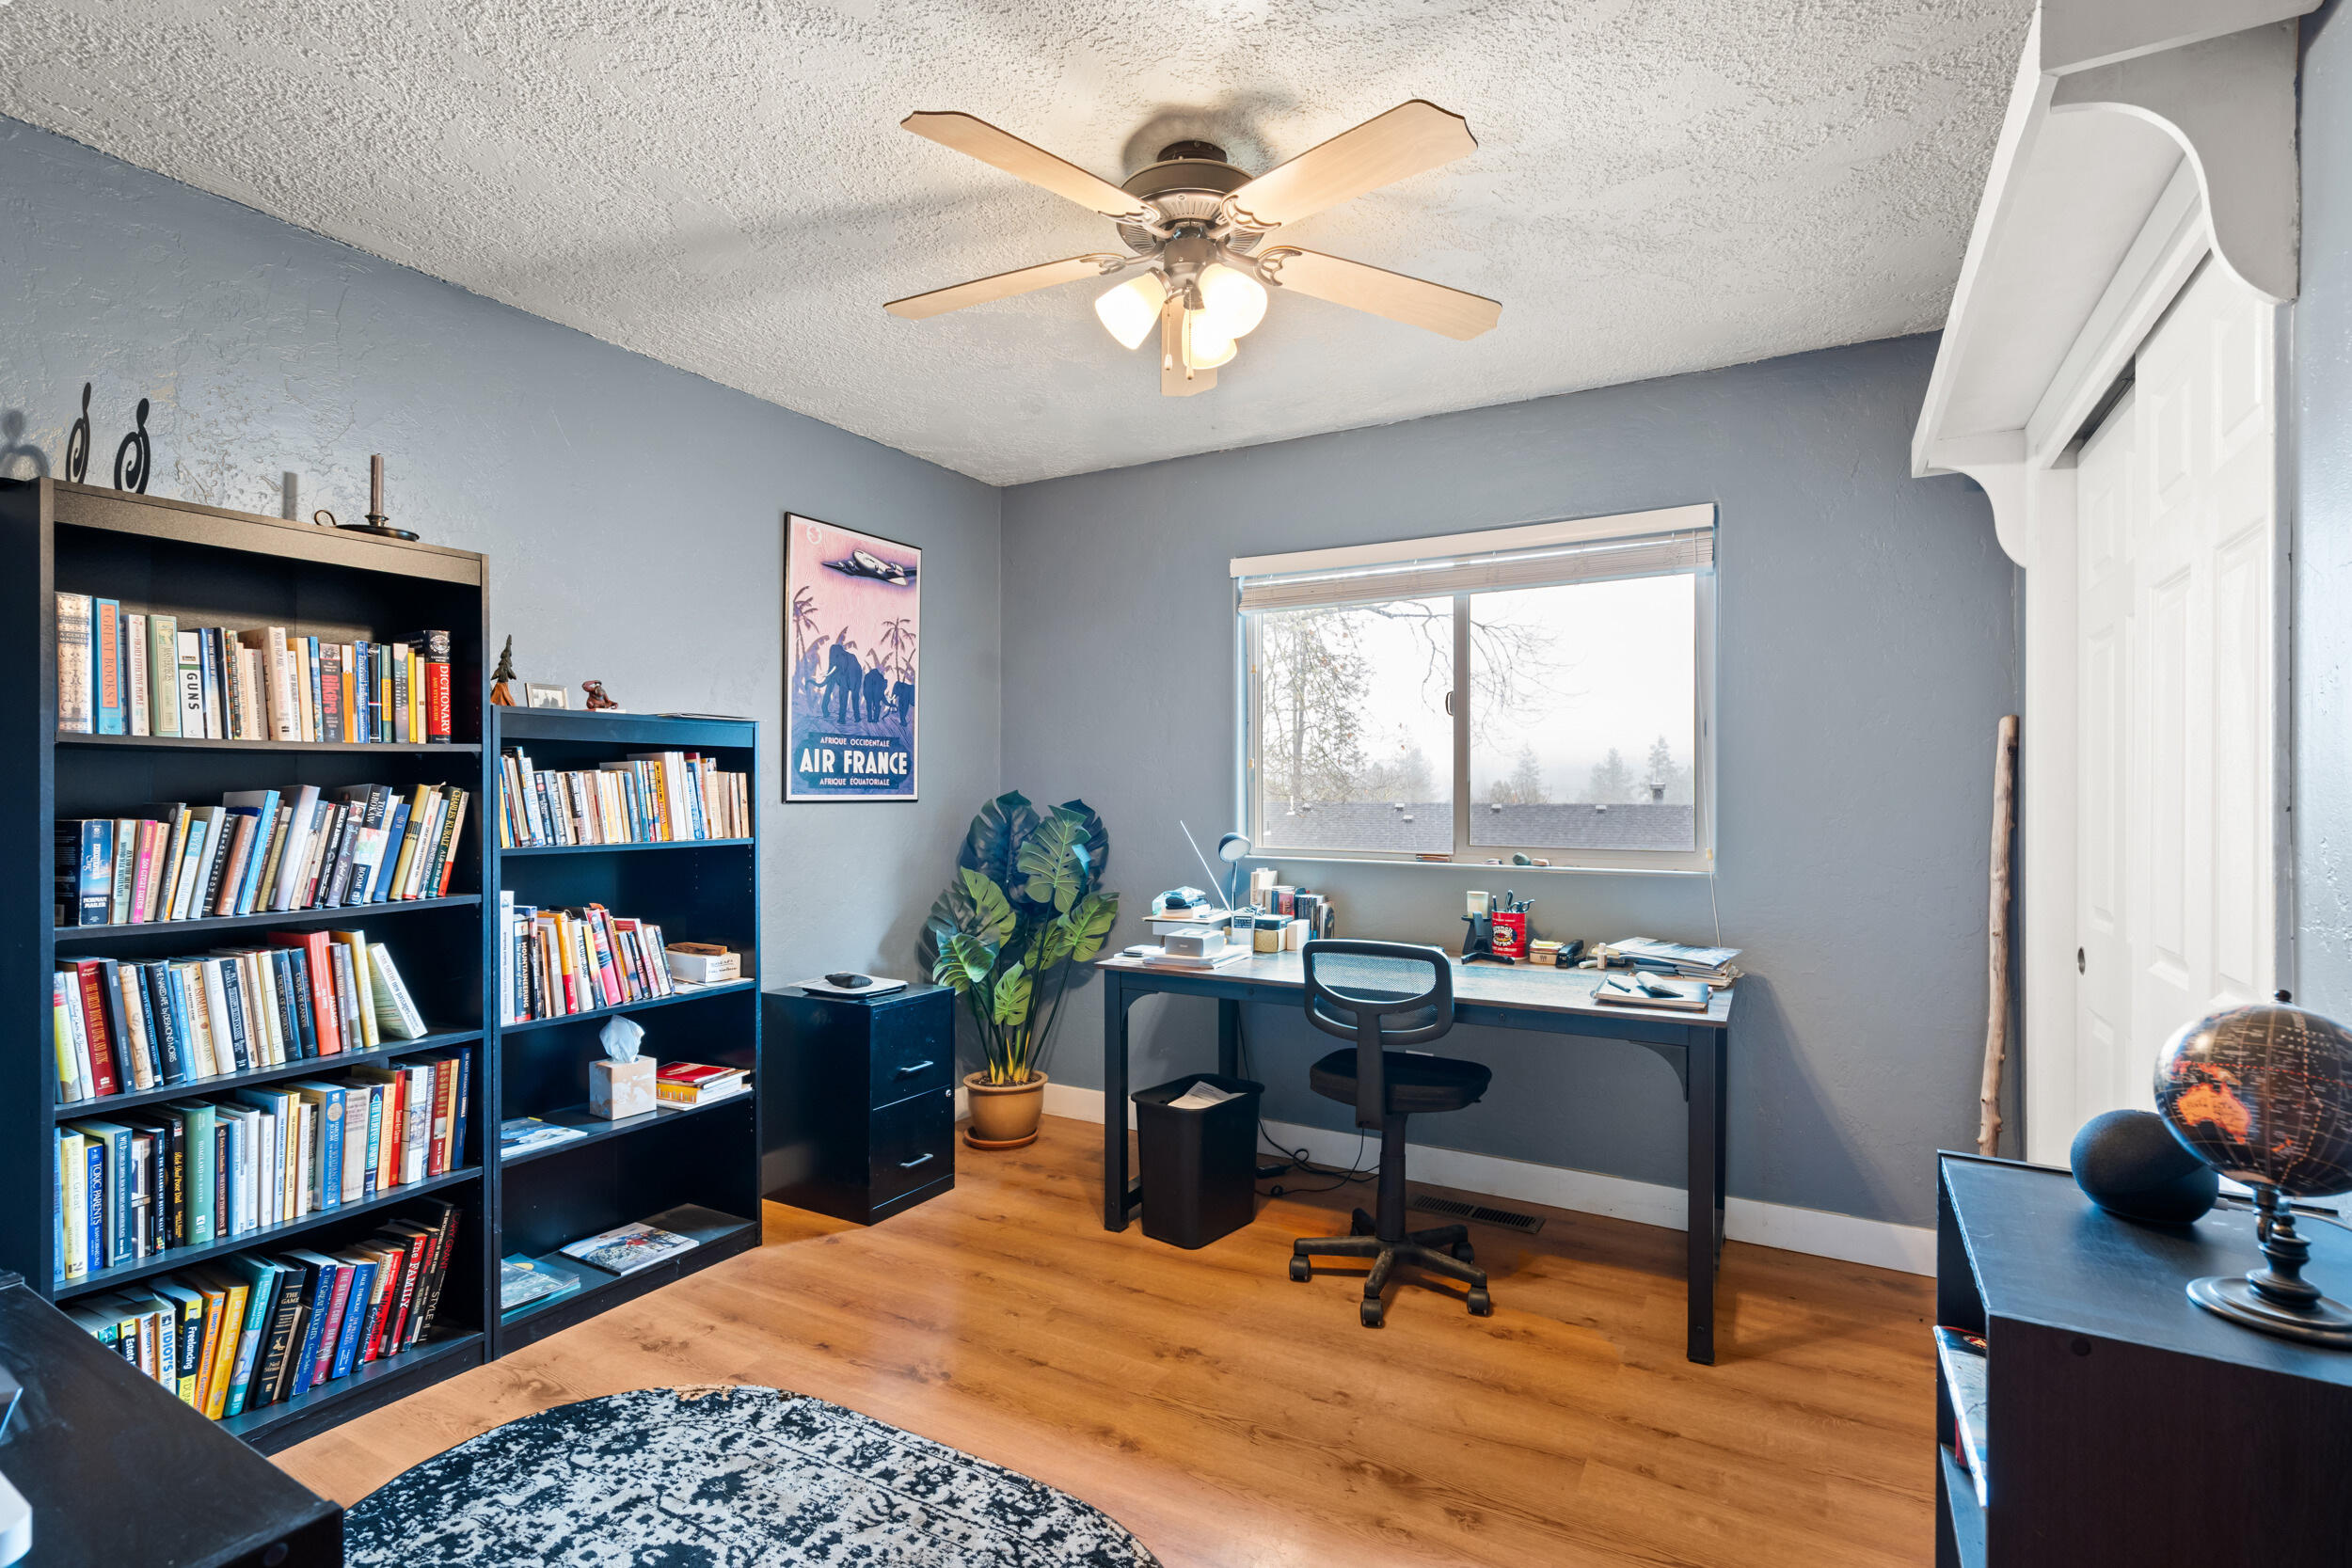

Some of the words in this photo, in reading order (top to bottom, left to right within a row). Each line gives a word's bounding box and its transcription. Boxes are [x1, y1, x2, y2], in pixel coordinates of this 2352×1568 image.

[102, 614, 114, 654] GREAT
[103, 657, 115, 697] BOOKS
[133, 657, 143, 685] EFFECTIVE
[134, 686, 143, 705] PEOPLE
[187, 672, 199, 710] GUNS
[320, 673, 341, 715] Bikers
[437, 665, 451, 733] DICTIONARY
[820, 736, 847, 745] AFRIQUE
[850, 738, 890, 747] OCCIDENTALE
[799, 748, 835, 773] AIR
[844, 750, 908, 775] FRANCE
[850, 776, 890, 786] ÉQUATORIALE
[335, 806, 346, 828] HELL'S
[365, 791, 380, 823] BROKAW
[375, 800, 386, 817] TOM
[446, 789, 461, 819] CHARLES
[330, 827, 341, 849] ANGEL
[439, 819, 454, 848] KURALT
[353, 865, 366, 889] BOOM!
[155, 966, 164, 978] THE
[294, 971, 303, 994] TROPIC
[520, 941, 529, 1007] MOUNTAINEERING
[157, 977, 167, 997] NAKED
[276, 974, 284, 997] TROPIC
[297, 994, 304, 1002] OF
[193, 986, 207, 1017] ISHMAEL
[278, 997, 285, 1005] OF
[162, 1013, 174, 1043] DESMOND
[166, 1042, 177, 1063] MORRIS
[435, 1063, 450, 1116] RESOLUTE
[92, 1161, 102, 1188] TOXIC
[72, 1181, 81, 1210] Great
[92, 1190, 102, 1225] PARENTS
[437, 1217, 448, 1245] ENCYCLOPEDIA
[411, 1239, 422, 1259] The
[439, 1238, 454, 1270] GRANT
[322, 1273, 331, 1285] THE
[337, 1283, 346, 1292] DA
[339, 1270, 349, 1283] THE
[359, 1272, 367, 1287] PAUL
[399, 1259, 420, 1310] FAMILY
[316, 1284, 328, 1307] GREAT
[333, 1291, 344, 1308] VINCI
[353, 1287, 364, 1313] THEROUX
[376, 1289, 390, 1315] Helter
[424, 1290, 439, 1321] STYLE
[209, 1312, 218, 1336] IDIOT'S
[309, 1306, 324, 1341] THOUGHTS
[329, 1308, 340, 1326] CODE
[124, 1337, 136, 1361] Estate
[161, 1330, 174, 1371] IDIOT'S
[182, 1325, 198, 1370] Freelancing
[227, 1330, 236, 1346] YOU
[200, 1339, 212, 1375] Vegetable
